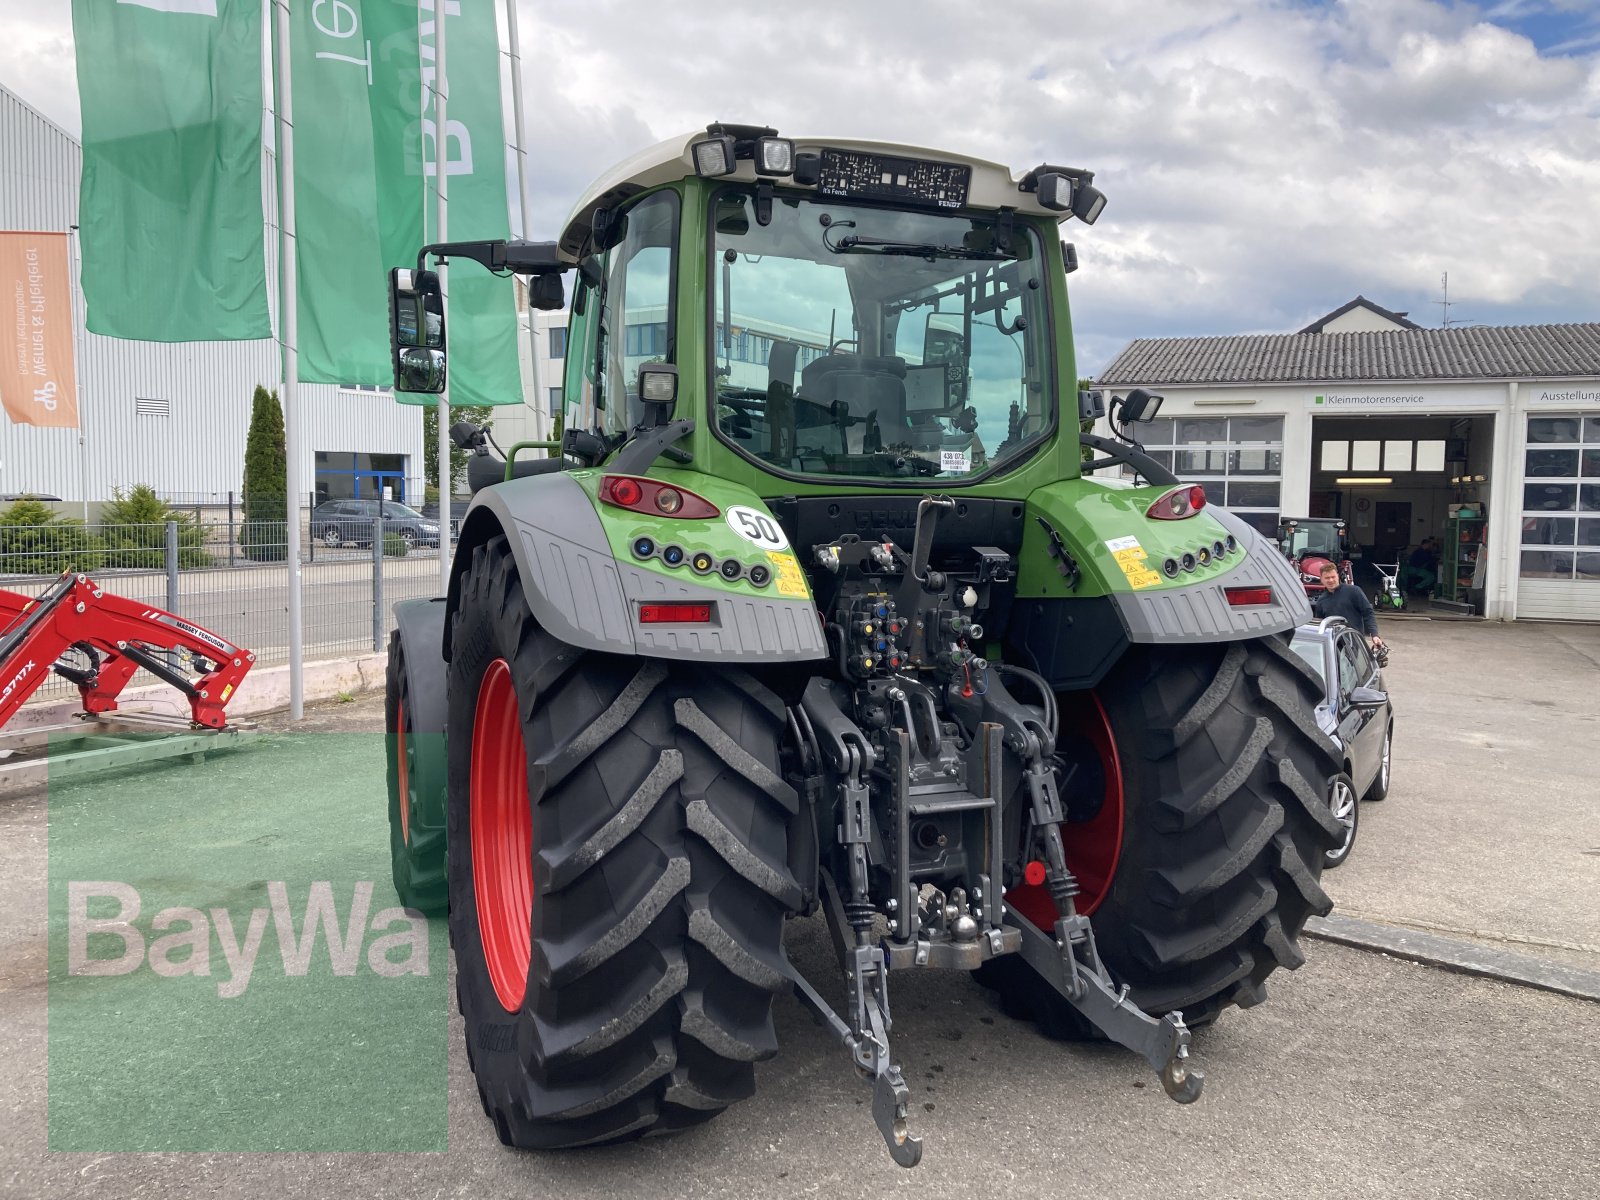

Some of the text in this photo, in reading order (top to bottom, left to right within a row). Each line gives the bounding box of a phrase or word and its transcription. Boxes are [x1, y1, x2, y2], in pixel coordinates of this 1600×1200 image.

[938, 200, 962, 208] FENDT
[1327, 394, 1425, 404] Kleinmotorenservice
[1540, 390, 1600, 402] Ausstellung
[735, 510, 780, 544] 50
[175, 621, 225, 649] MASSEY FERGUSON
